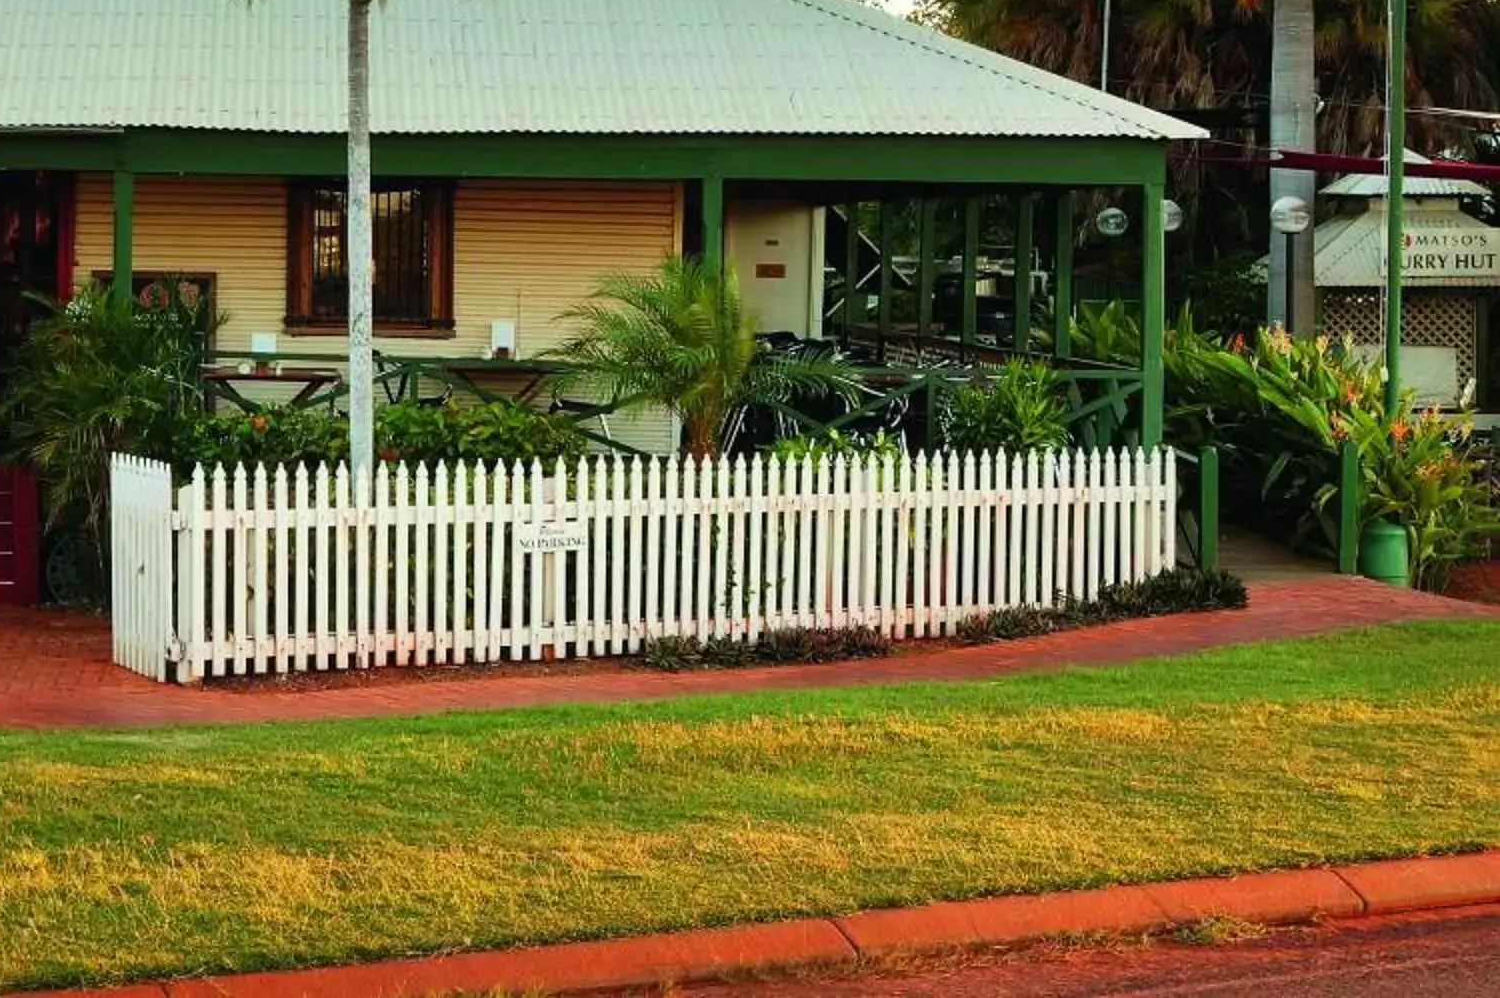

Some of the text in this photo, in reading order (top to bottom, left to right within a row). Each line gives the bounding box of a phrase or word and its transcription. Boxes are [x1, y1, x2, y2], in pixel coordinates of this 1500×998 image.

[1415, 234, 1488, 247] MATSO'S
[1384, 253, 1497, 269] URRY HUT
